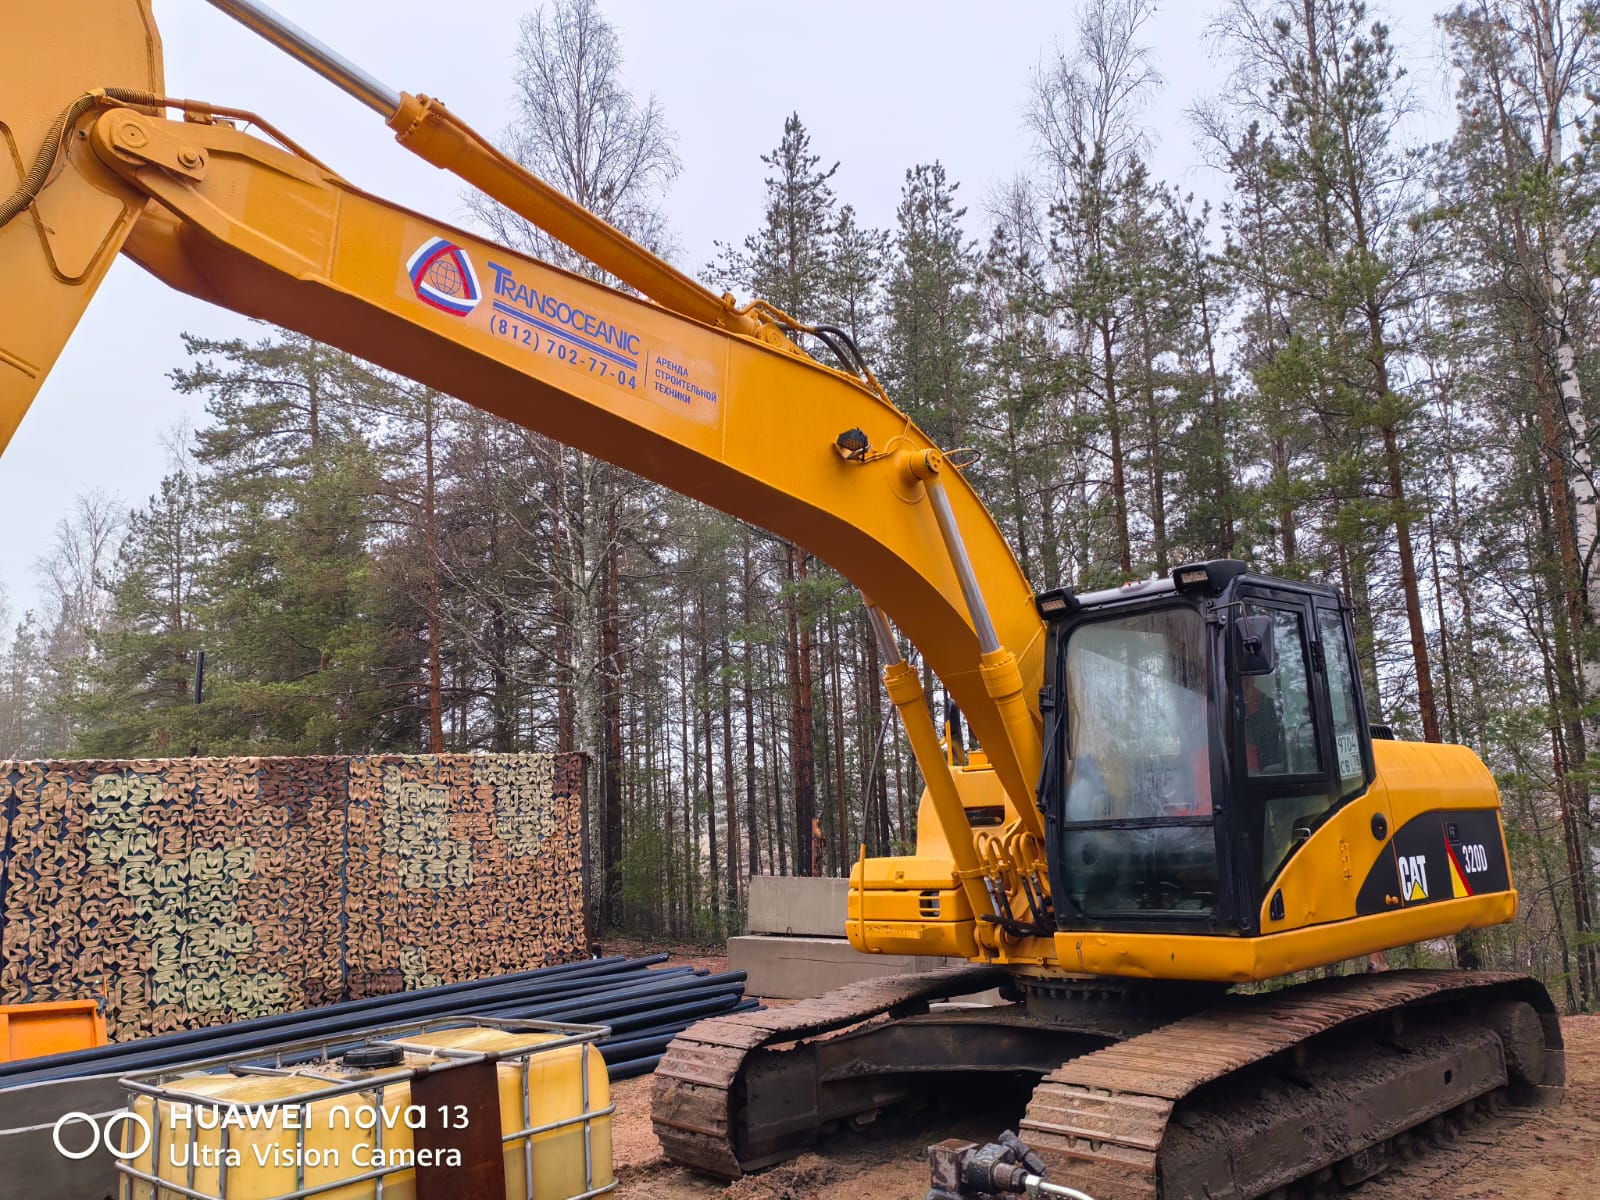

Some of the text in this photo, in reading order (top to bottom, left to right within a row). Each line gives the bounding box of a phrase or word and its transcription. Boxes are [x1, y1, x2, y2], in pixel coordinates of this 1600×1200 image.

[490, 314, 637, 390] (812) 702-77-04
[656, 356, 689, 377] АРЕНДА
[654, 380, 691, 405] ТЕХНИКИ
[655, 368, 717, 403] СТРОИТЕЛЬНОЙ
[1462, 844, 1488, 873] 320D
[1398, 855, 1428, 901] CAT
